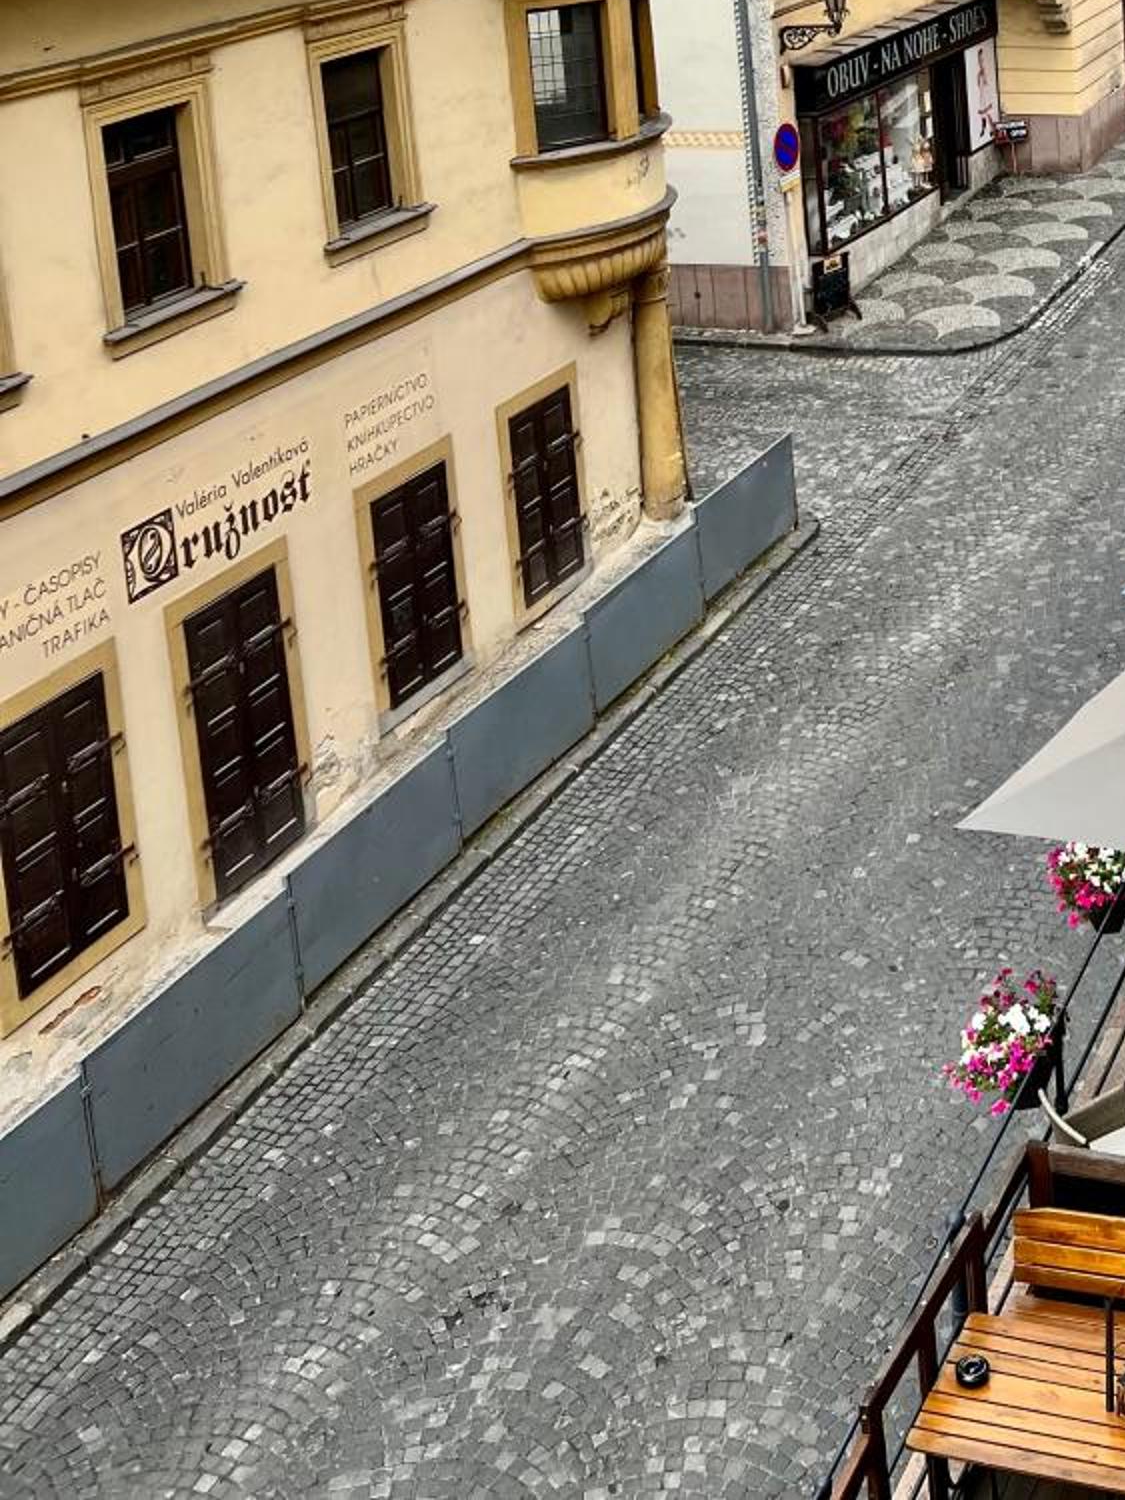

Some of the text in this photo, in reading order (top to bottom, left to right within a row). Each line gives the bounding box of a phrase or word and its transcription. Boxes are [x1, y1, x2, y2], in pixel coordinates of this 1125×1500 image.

[827, 5, 988, 98] OBUV NA NOHE SHOES
[350, 437, 399, 477] HRAČKY
[175, 484, 228, 519] Valéria
[23, 549, 102, 606] ČASOPISY
[66, 576, 107, 614] TLAČ
[42, 607, 111, 659] TRAFIKA
